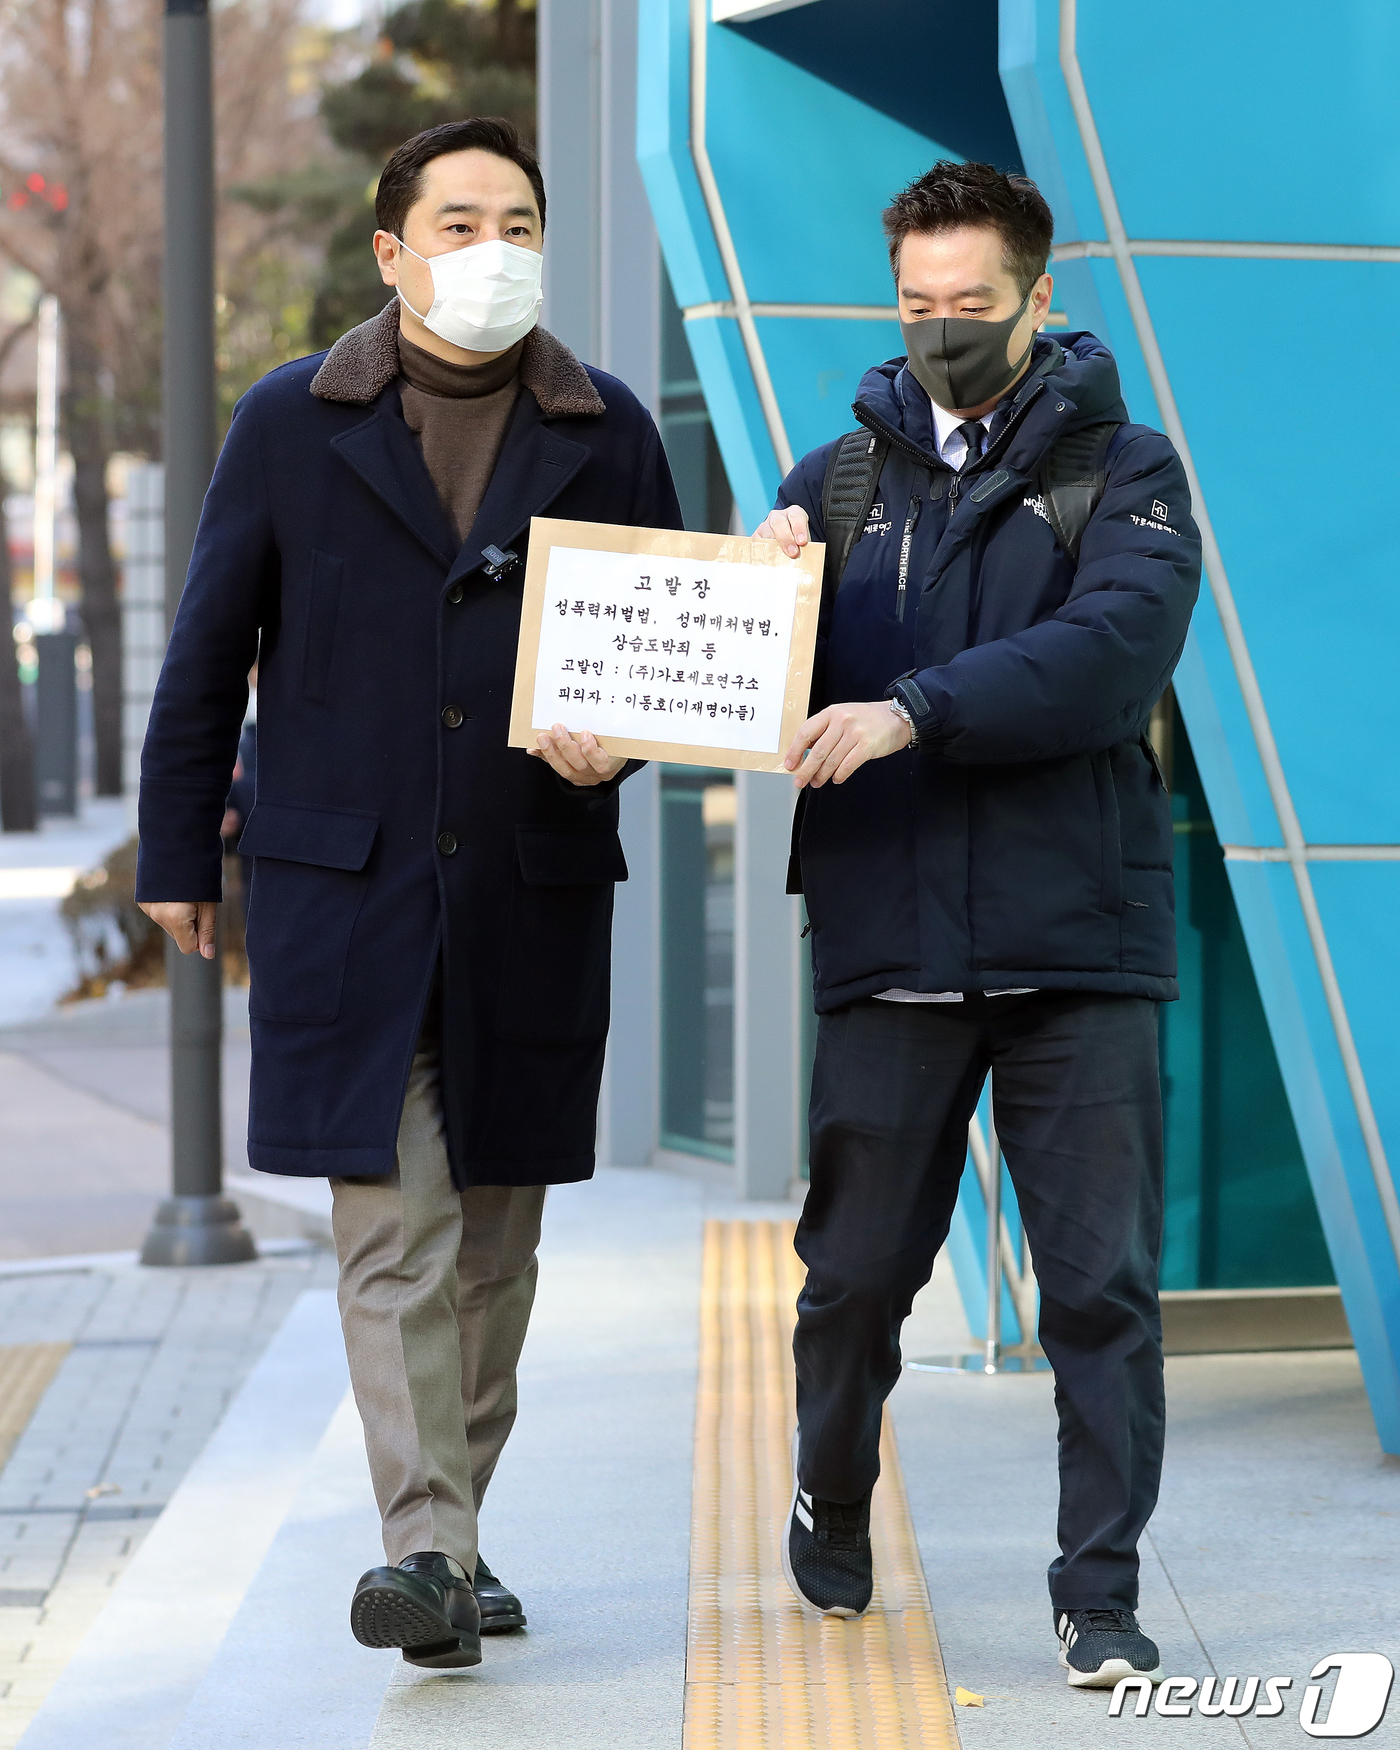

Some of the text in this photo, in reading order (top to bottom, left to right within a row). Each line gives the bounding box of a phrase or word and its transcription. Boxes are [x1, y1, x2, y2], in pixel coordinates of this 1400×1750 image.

[900, 534, 912, 565] NORTH
[898, 566, 907, 591] FACE
[612, 633, 716, 660] 상습도박죄 등
[561, 658, 604, 676] 고발인
[629, 664, 759, 690] (주)가로세로연구소
[558, 686, 602, 706] 피의자
[625, 693, 755, 721] 이동호(이재명아들)
